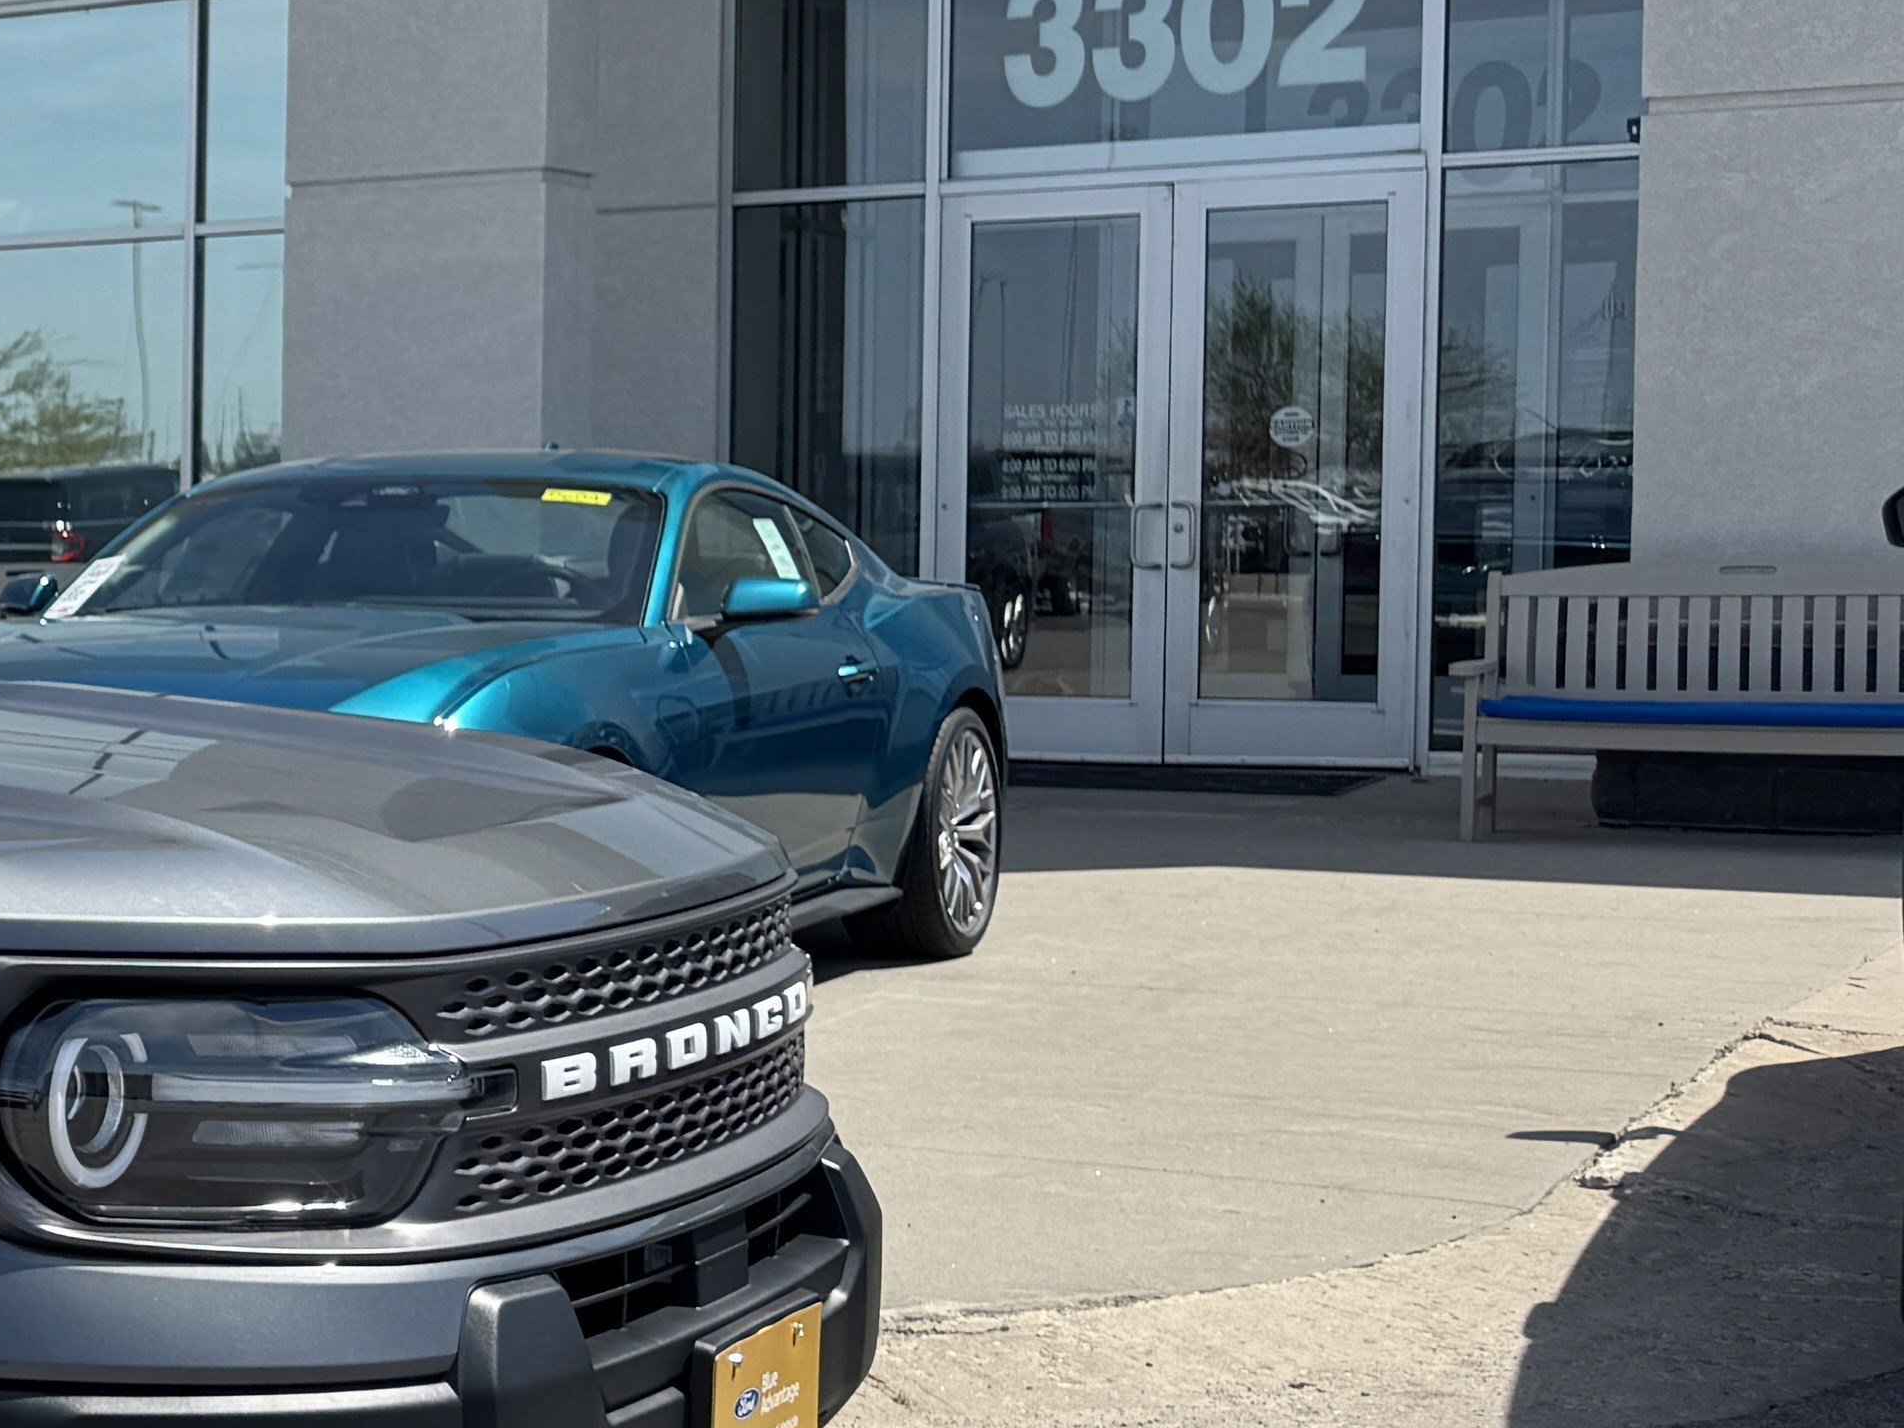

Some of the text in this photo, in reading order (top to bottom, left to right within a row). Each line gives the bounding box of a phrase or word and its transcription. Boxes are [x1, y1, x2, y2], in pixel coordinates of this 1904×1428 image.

[1024, 458, 1041, 472] AM
[1044, 458, 1058, 472] TO
[1023, 484, 1041, 500] AM
[1043, 484, 1057, 500] TO
[541, 980, 808, 1102] BRONCO
[761, 1382, 799, 1415] Advantage
